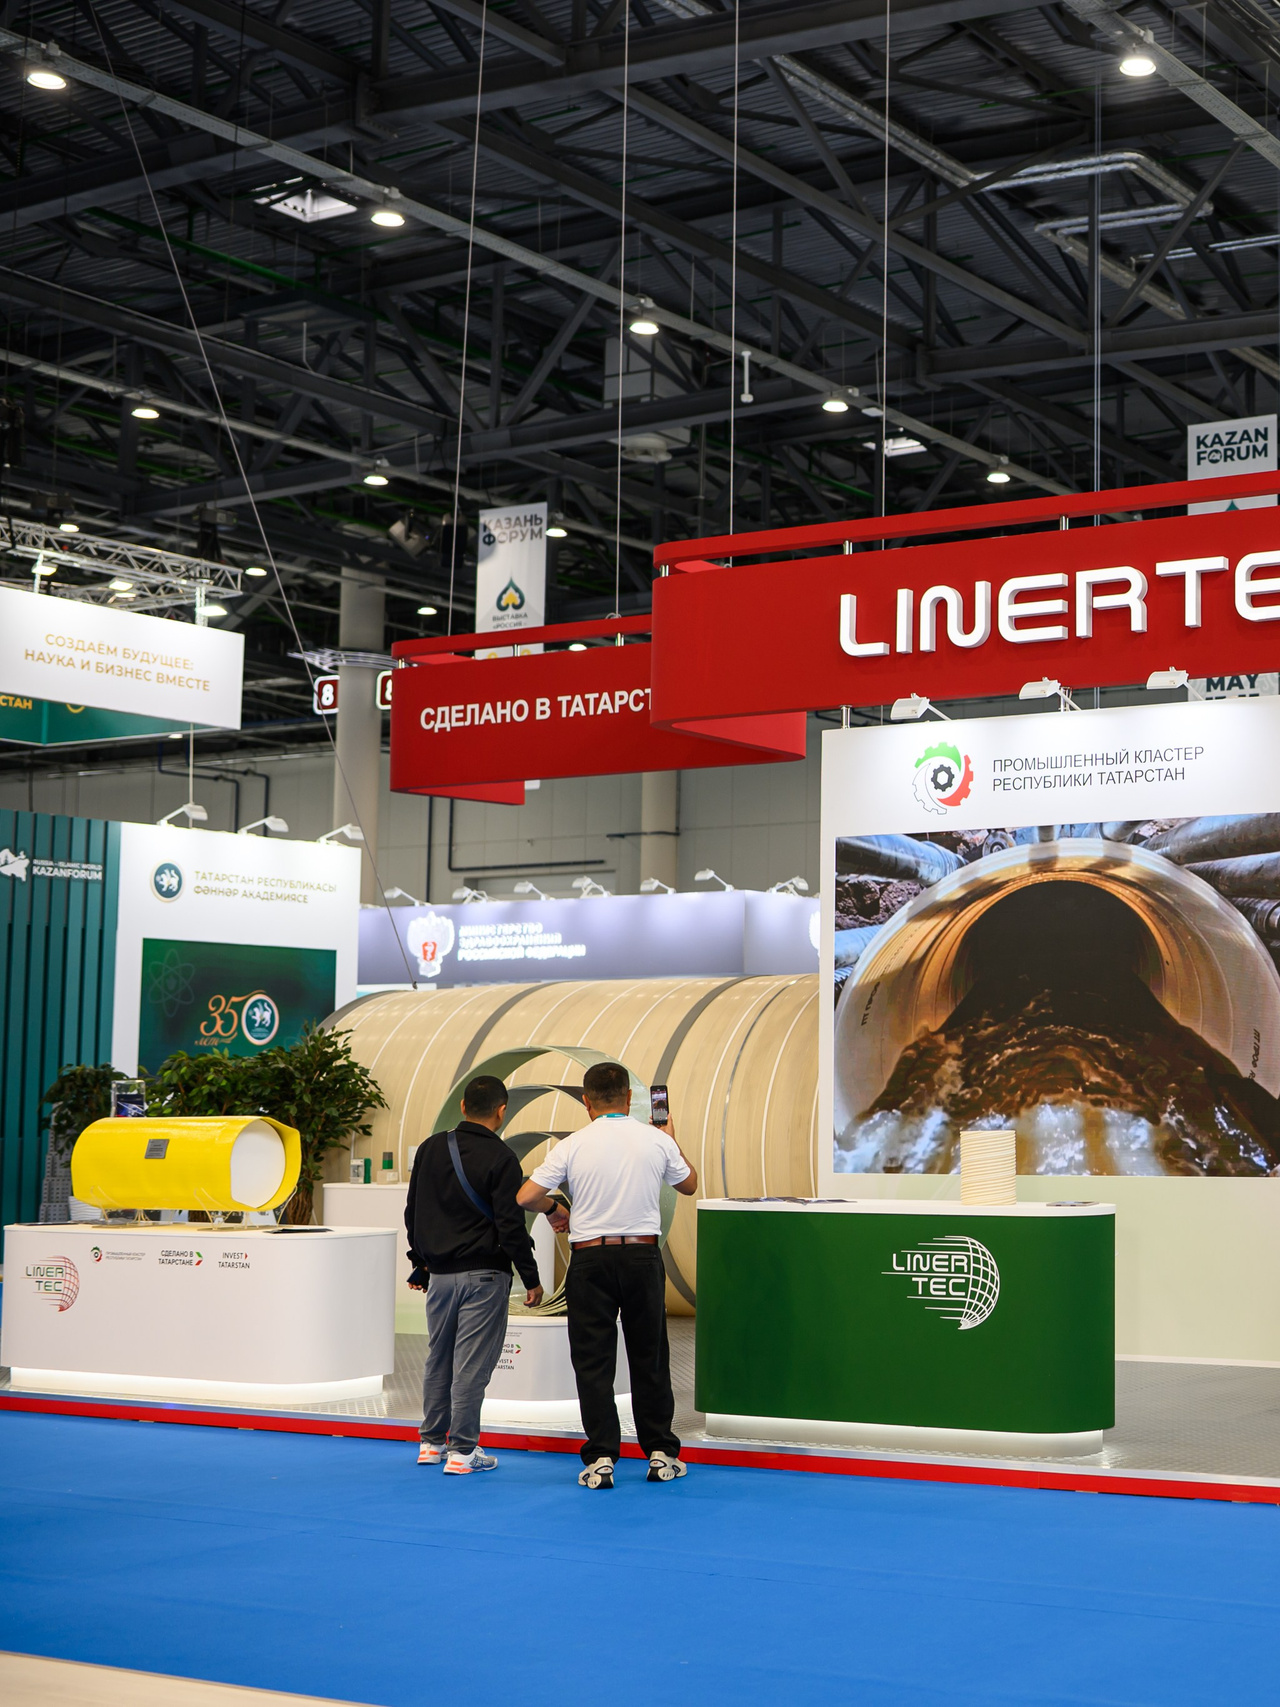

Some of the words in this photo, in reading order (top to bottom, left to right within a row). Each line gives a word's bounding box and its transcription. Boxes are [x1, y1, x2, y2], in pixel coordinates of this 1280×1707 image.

[1196, 427, 1268, 450] KAZAN
[1196, 443, 1268, 466] FORUM
[483, 514, 543, 532] КАЗАНЬ
[482, 527, 543, 546] ФОРУМ
[122, 647, 194, 671] БУДУЩЕЕ:
[24, 648, 76, 669] НАУКА
[81, 660, 90, 670] И
[95, 661, 152, 682] БИЗНЕС
[156, 672, 210, 691] ВМЕСТЕ
[1206, 674, 1259, 692] MAY
[321, 683, 334, 706] 8
[420, 699, 529, 733] СДЕЛАНО
[535, 697, 551, 720] В
[993, 749, 1130, 772] ПРОМЫШЛЕННЫЙ
[1134, 746, 1204, 764] КЛАСТЕР
[993, 773, 1092, 791] РЕСПУБЛИКИ
[1097, 767, 1185, 785] ТАТАРСТАН
[33, 866, 102, 880] KAZANFORUM
[195, 871, 254, 885] ТАТАРСТАН
[257, 877, 337, 892] РЕСПУБЛИКАСЫ
[242, 890, 309, 904] АКАДЕМИЯСЕ
[158, 1258, 193, 1266] ТАТАРСТАНЕ
[218, 1261, 250, 1269] TATARSTAN
[892, 1253, 968, 1272] LINER
[25, 1266, 64, 1278] LINER
[35, 1280, 63, 1292] TEC
[912, 1277, 966, 1296] TEC
